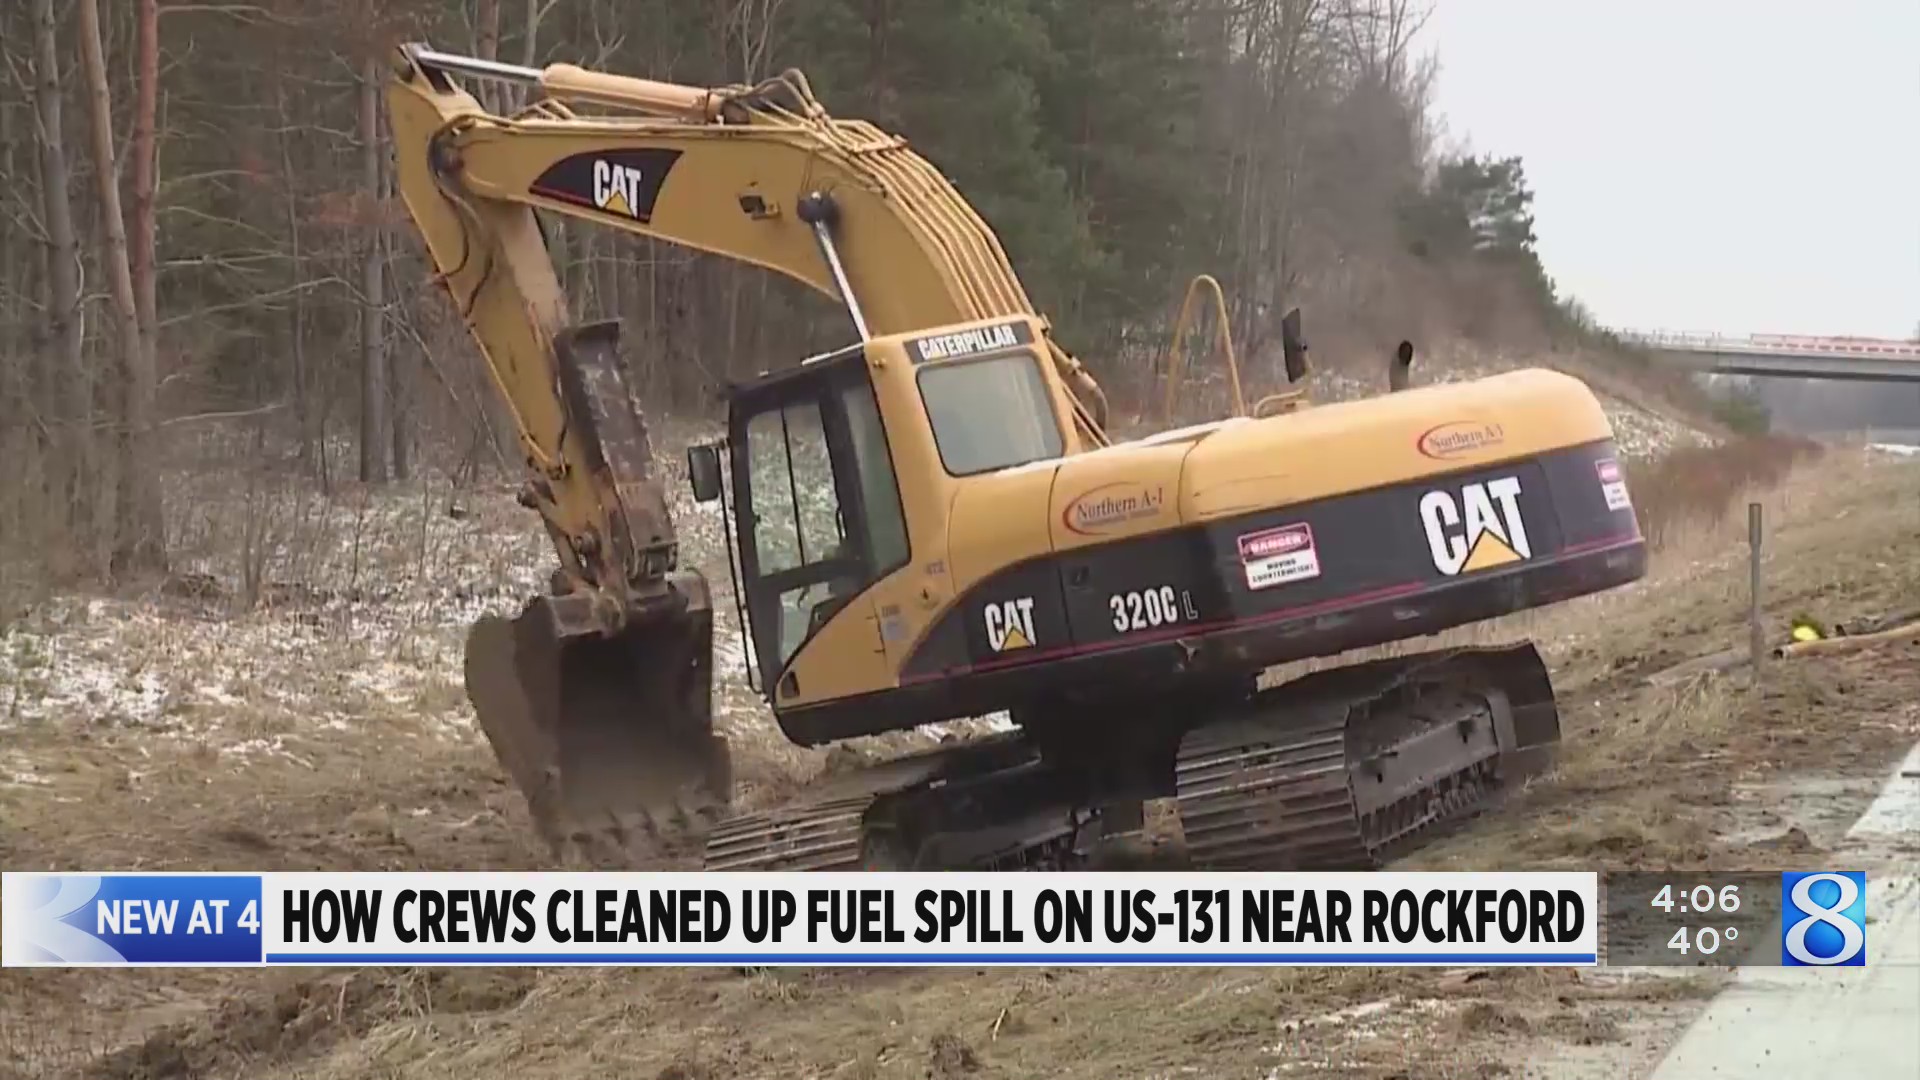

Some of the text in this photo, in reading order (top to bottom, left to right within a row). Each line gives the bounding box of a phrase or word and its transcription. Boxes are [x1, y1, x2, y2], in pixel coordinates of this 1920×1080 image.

[594, 160, 641, 218] CAT
[918, 325, 1017, 360] CATERPILLAR
[1430, 428, 1482, 448] Northern
[1077, 496, 1136, 519] Northern
[1420, 476, 1531, 575] CAT
[984, 598, 1037, 652] CAT
[1110, 586, 1198, 632] 320C L
